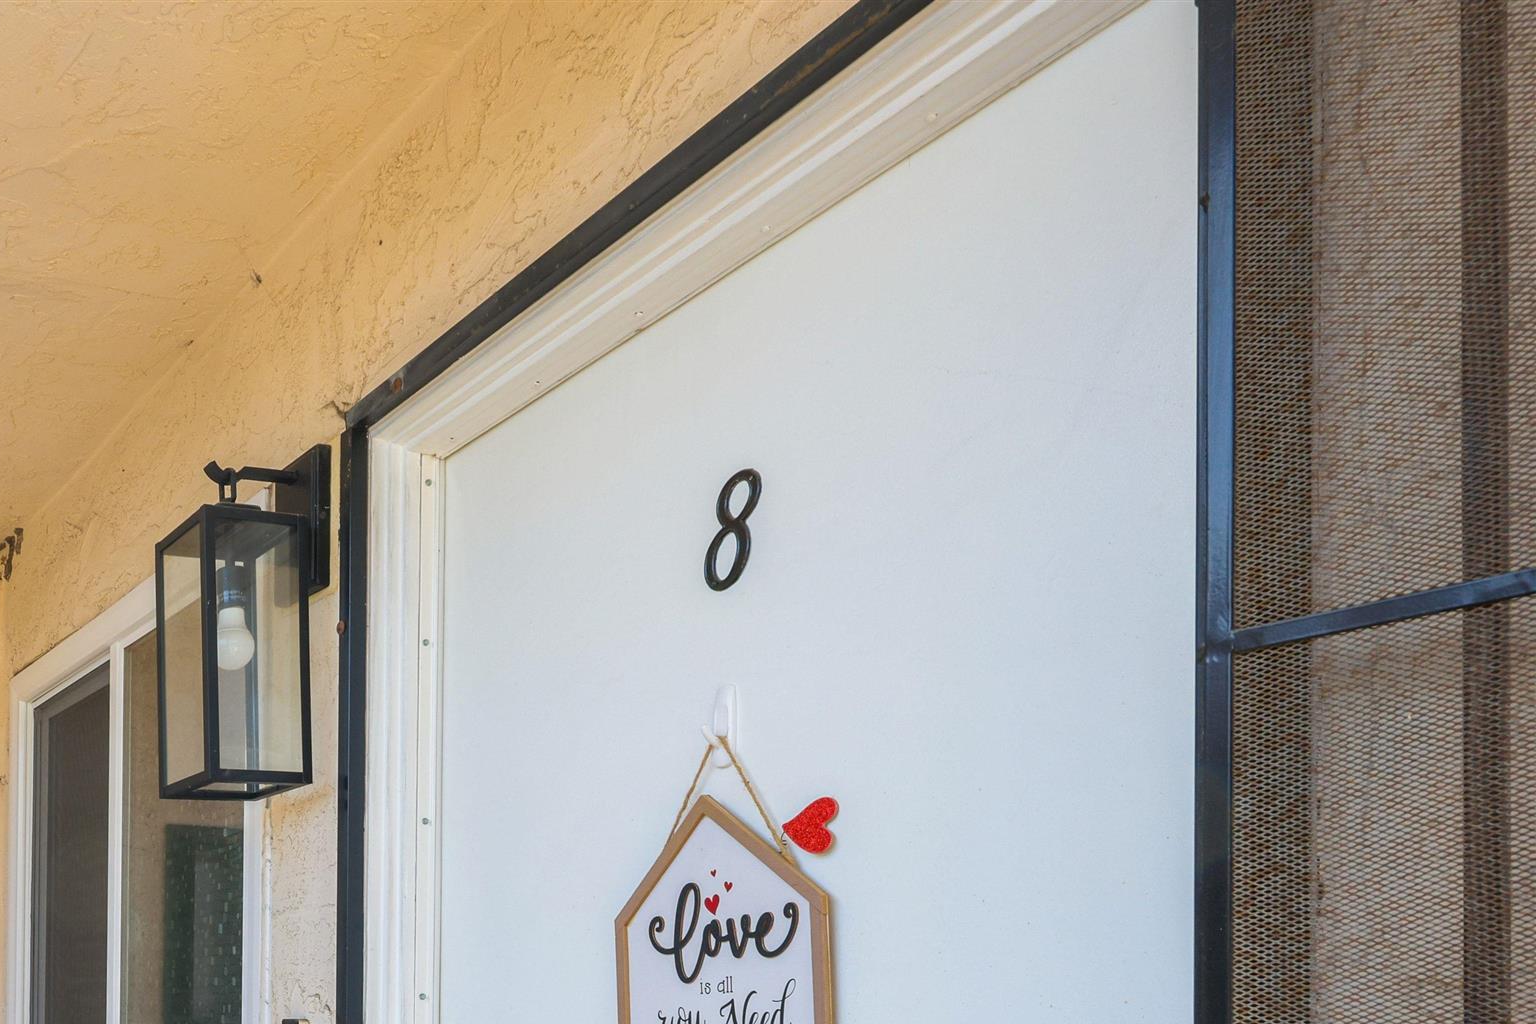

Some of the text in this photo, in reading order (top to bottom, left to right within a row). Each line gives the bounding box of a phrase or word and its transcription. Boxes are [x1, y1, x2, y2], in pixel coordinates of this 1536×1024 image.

[703, 467, 762, 592] 8
[699, 976, 734, 995] is all
